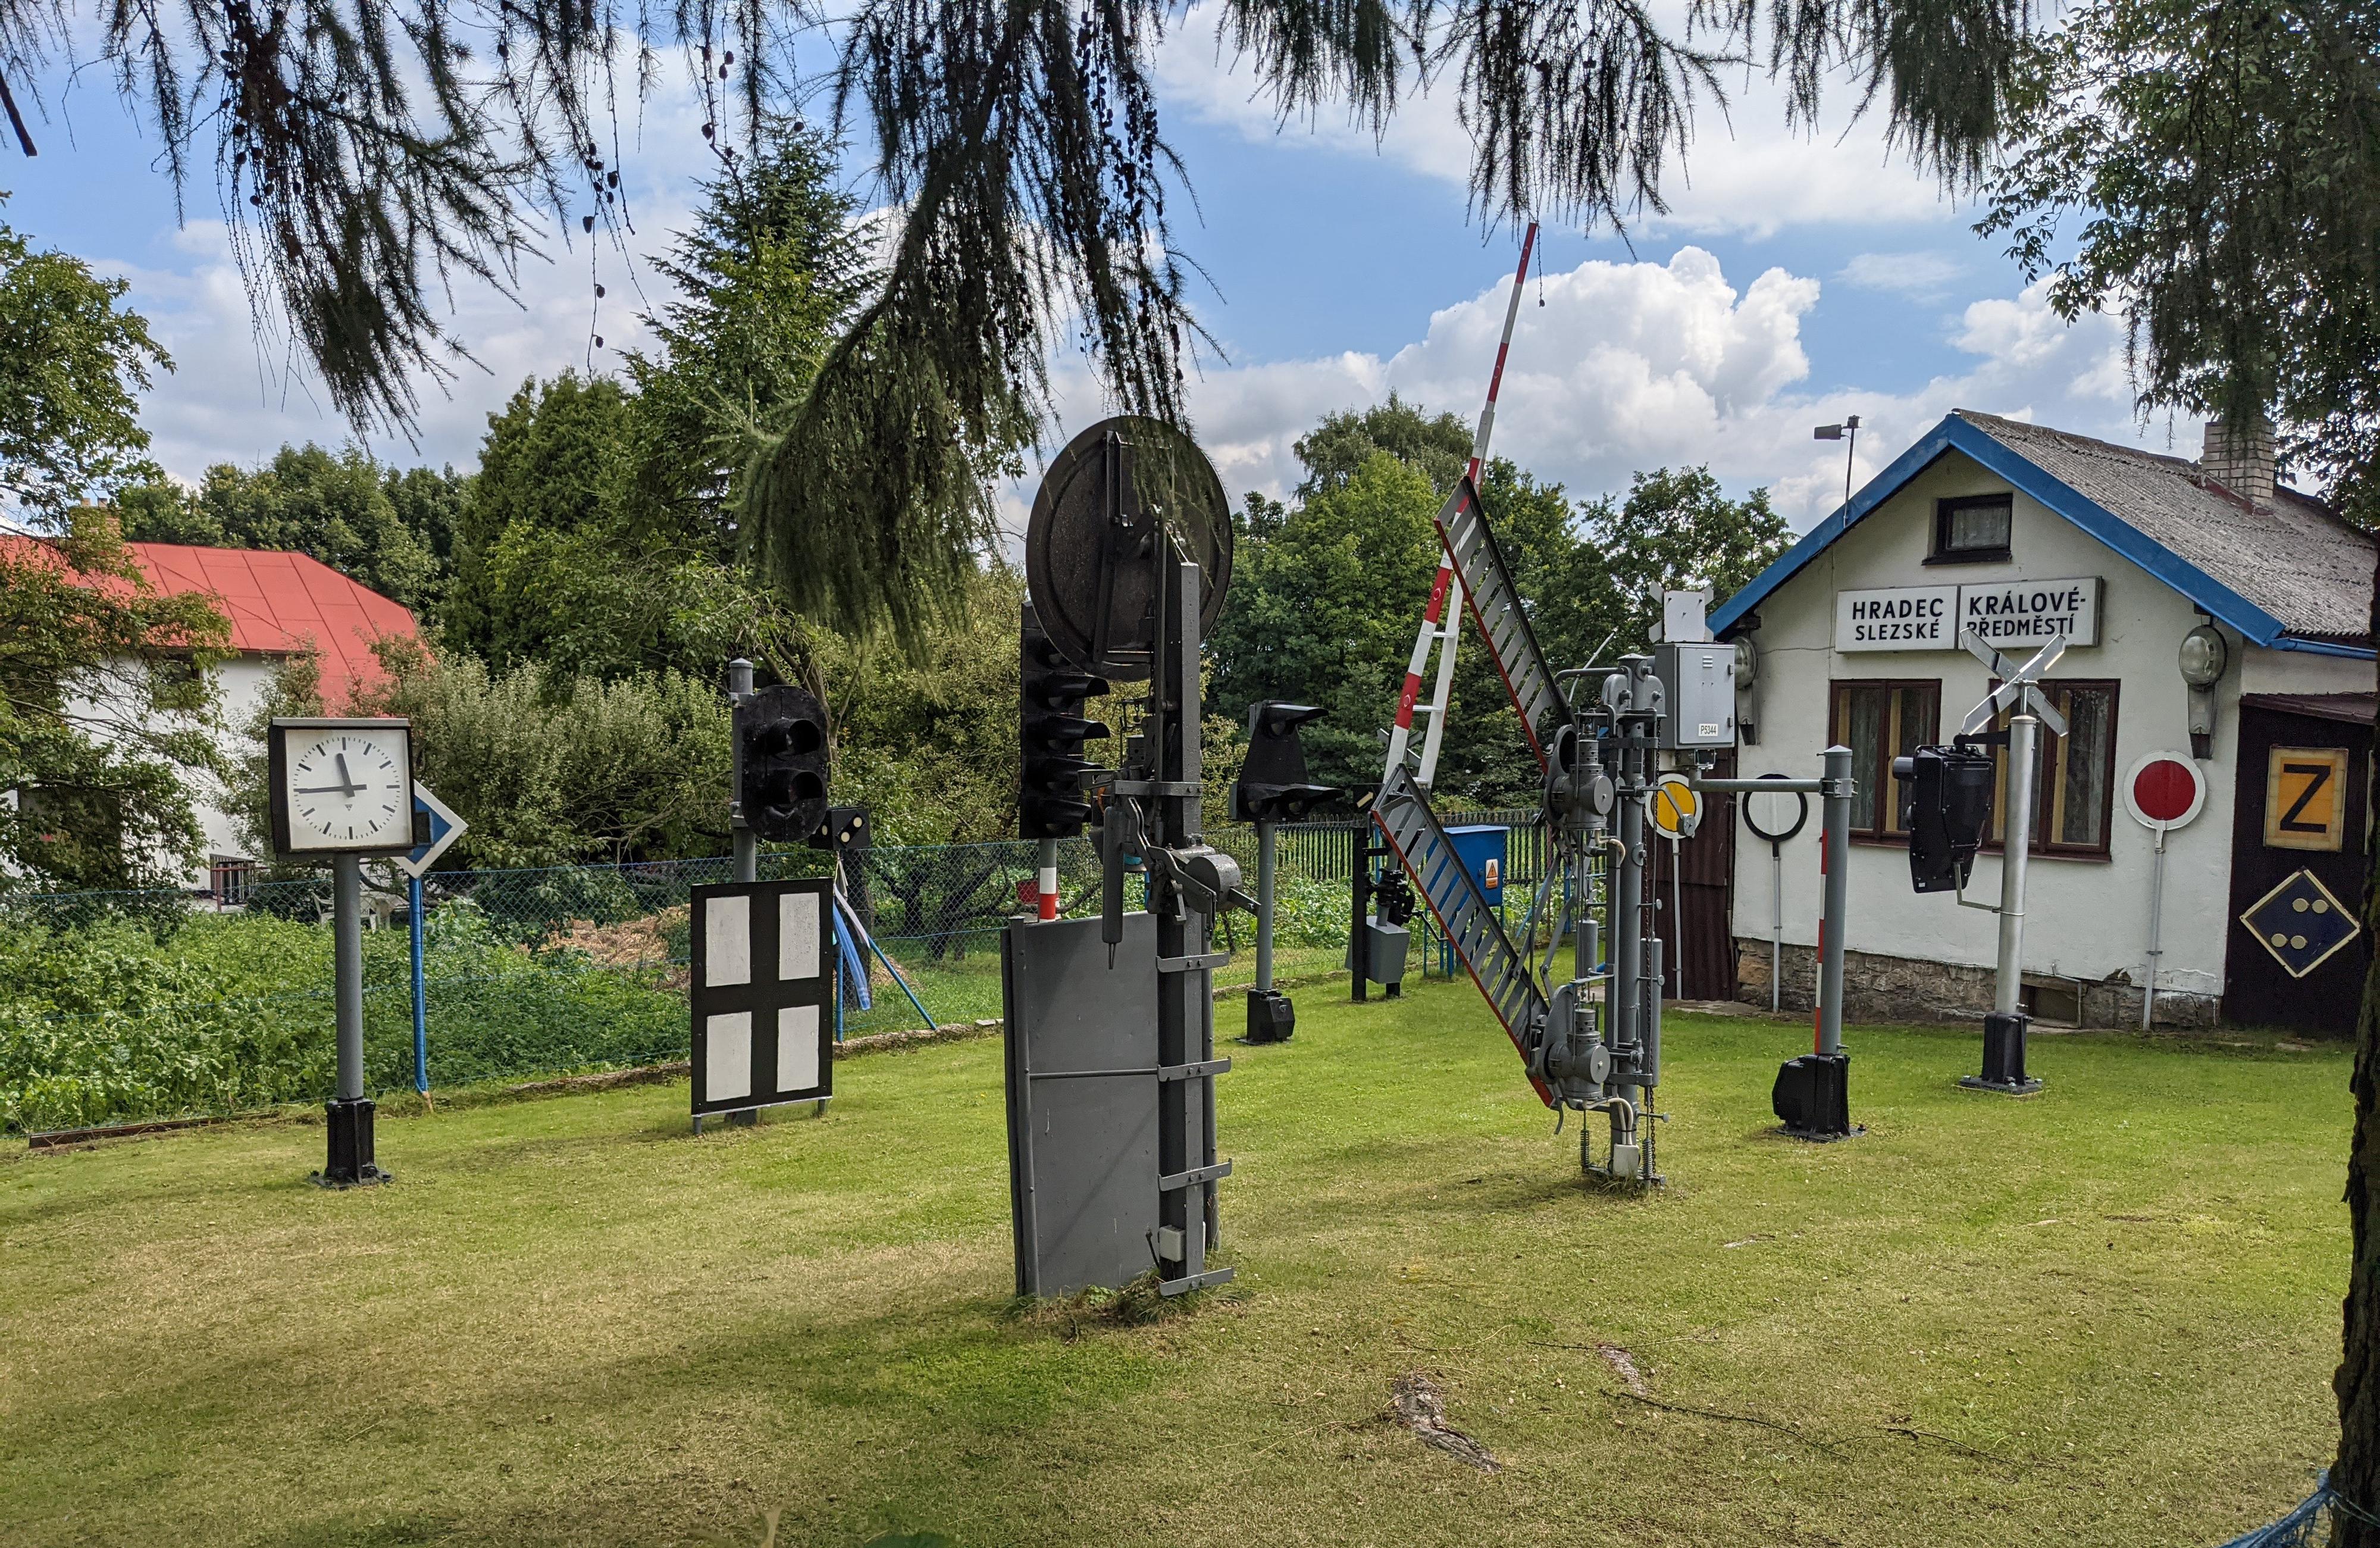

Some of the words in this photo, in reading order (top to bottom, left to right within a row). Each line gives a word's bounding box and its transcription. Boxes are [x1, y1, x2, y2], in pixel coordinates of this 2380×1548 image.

[1852, 598, 1943, 620] HRADEC
[1969, 587, 2085, 615] KRÁLOVÉ-
[1855, 618, 1939, 640] SLEZSKÉ
[1966, 613, 2075, 637] PŘEDMĚSTÍ
[1701, 725, 1717, 734] P5344
[2279, 763, 2331, 833] Z
